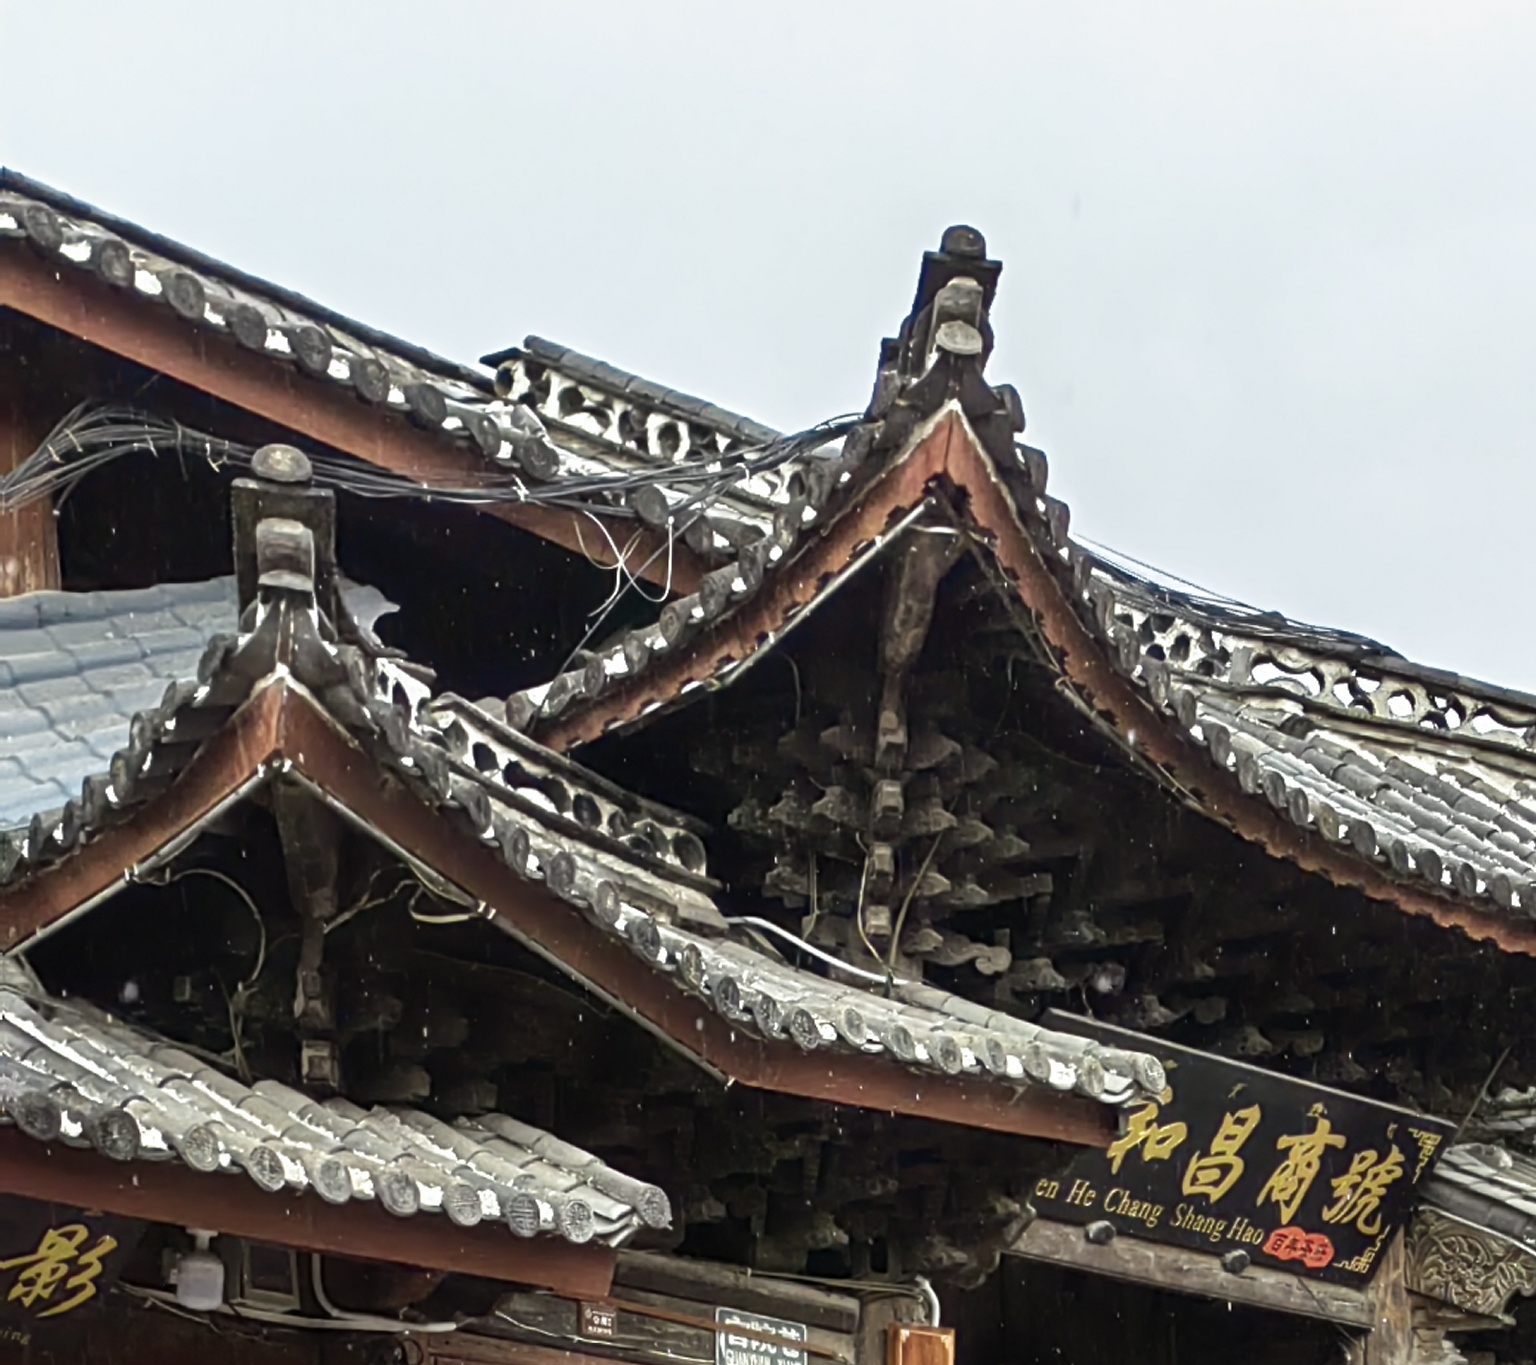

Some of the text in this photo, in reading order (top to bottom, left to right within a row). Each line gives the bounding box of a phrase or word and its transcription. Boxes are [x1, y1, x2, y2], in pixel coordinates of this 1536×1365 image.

[1035, 1178, 1264, 1246] en He Chang Shang Hao
